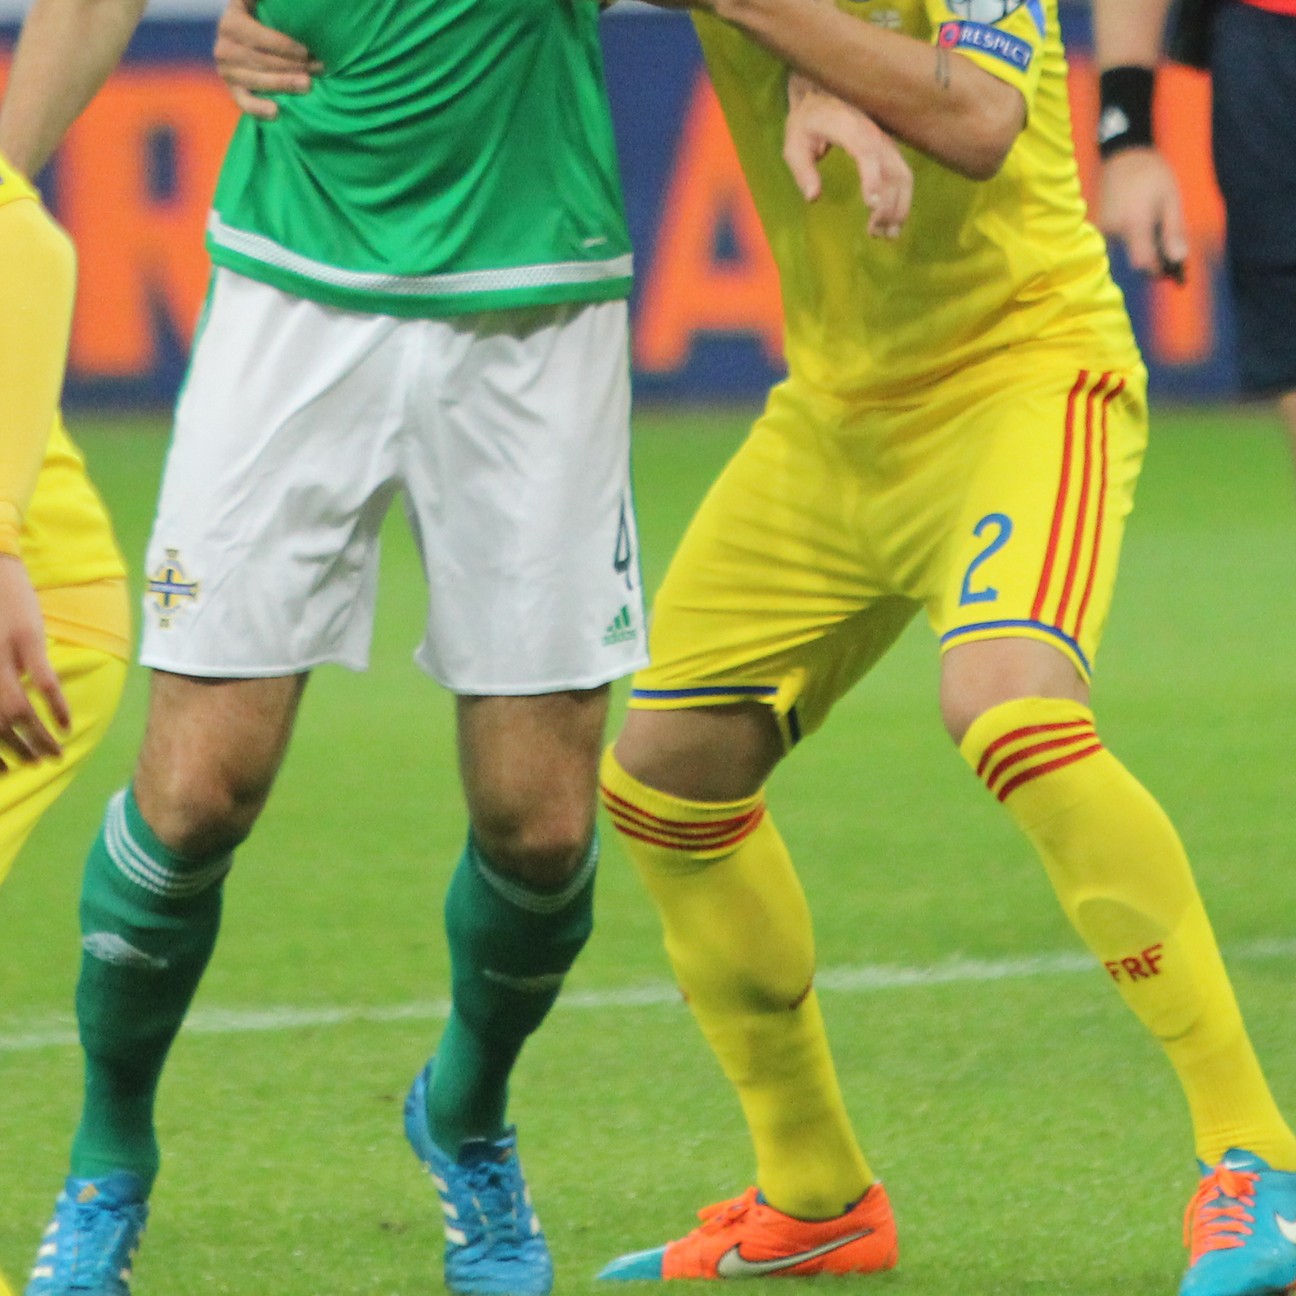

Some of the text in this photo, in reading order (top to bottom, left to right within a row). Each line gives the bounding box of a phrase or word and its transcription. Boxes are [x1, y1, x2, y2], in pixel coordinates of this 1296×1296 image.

[960, 26, 1031, 67] RESPECT
[958, 512, 1013, 608] 2
[1105, 943, 1163, 982] FRF
